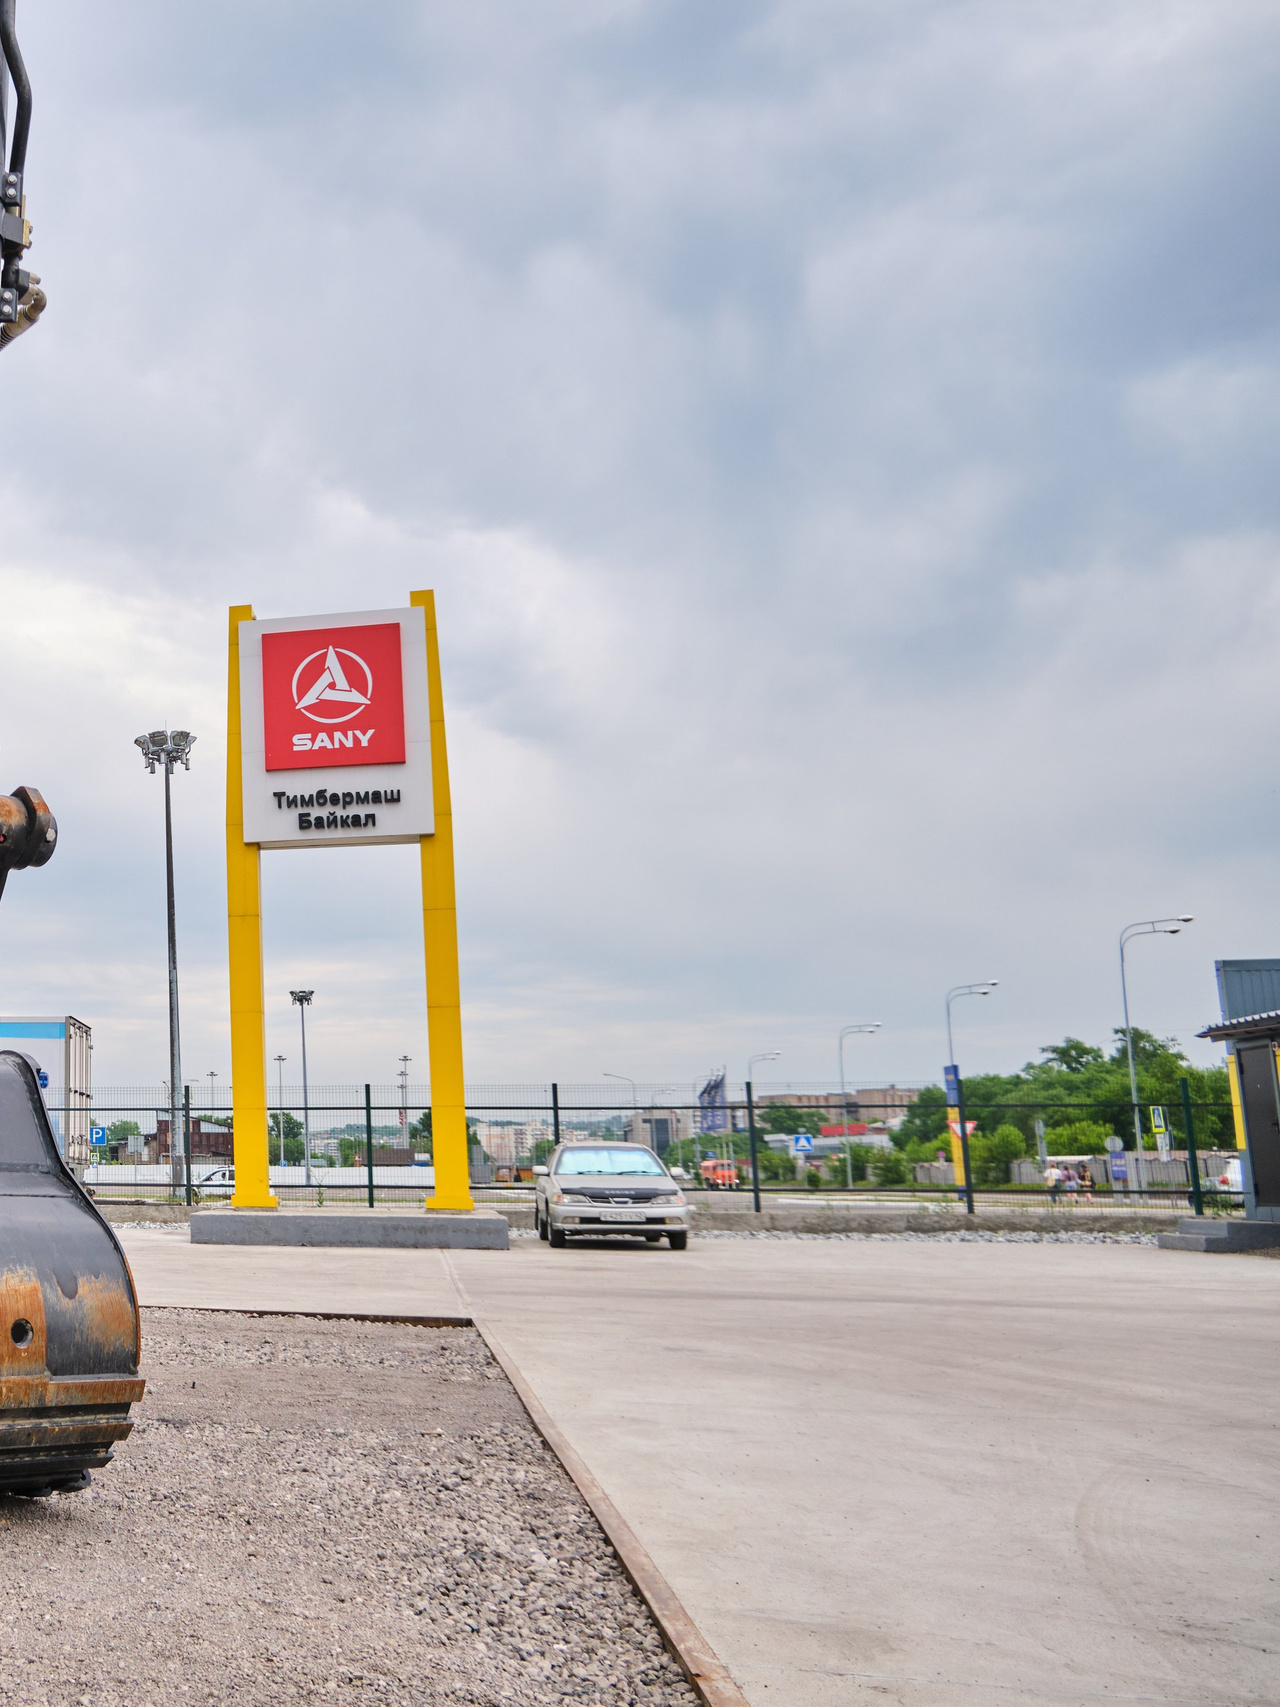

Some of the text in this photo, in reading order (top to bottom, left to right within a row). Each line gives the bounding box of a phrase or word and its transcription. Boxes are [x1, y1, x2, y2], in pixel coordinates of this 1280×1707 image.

[292, 729, 375, 751] SANY
[273, 789, 401, 809] Тимбермаш
[298, 811, 376, 830] Байкал
[93, 1129, 102, 1143] P
